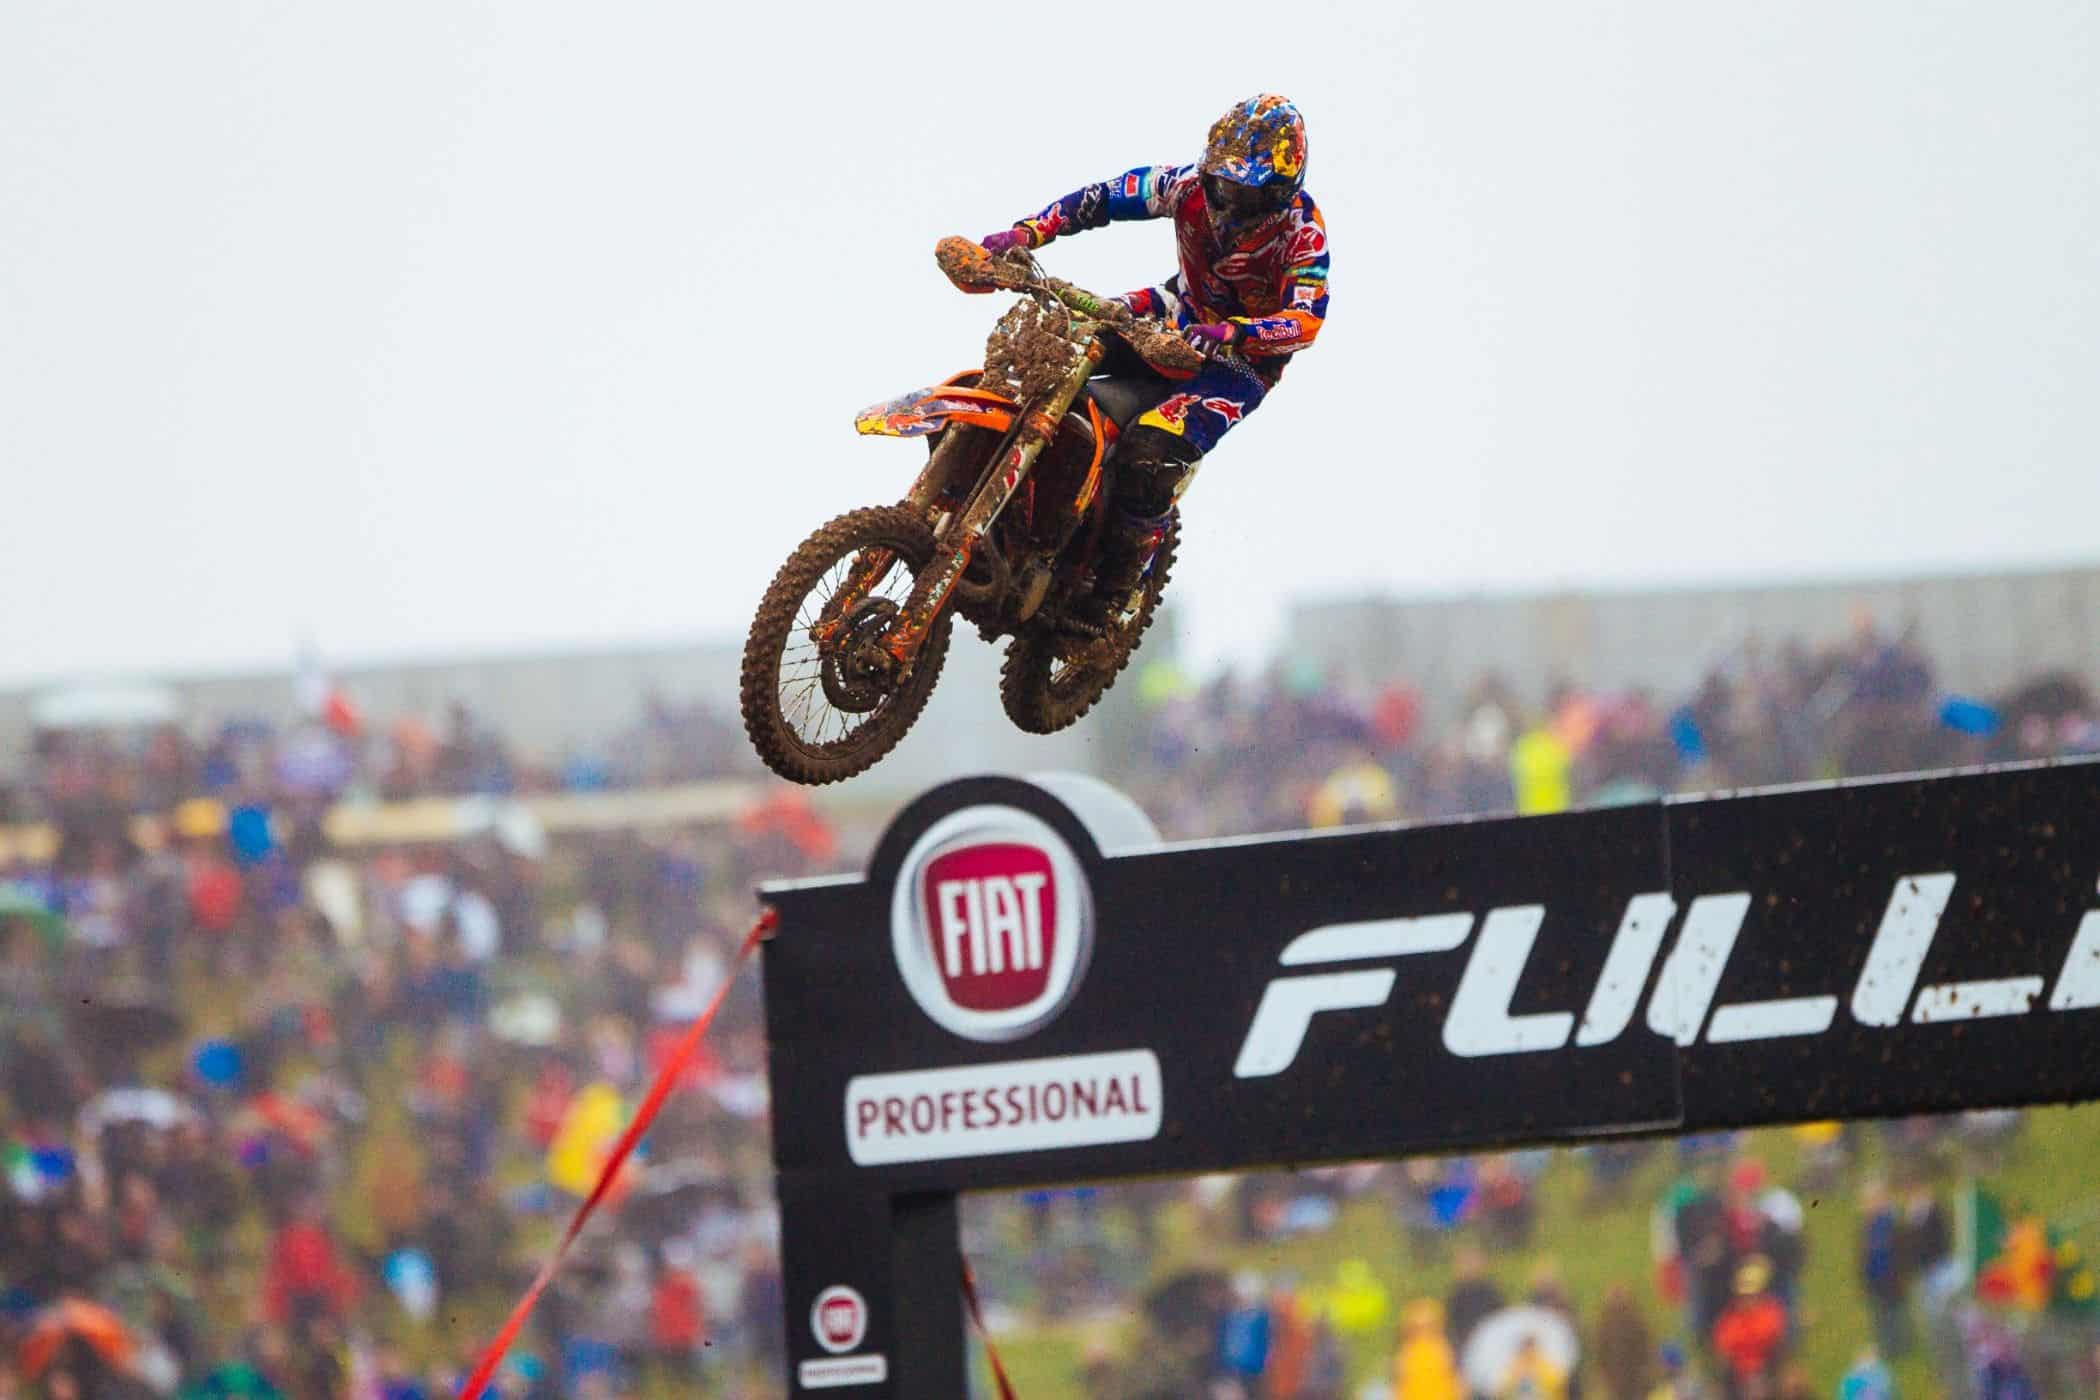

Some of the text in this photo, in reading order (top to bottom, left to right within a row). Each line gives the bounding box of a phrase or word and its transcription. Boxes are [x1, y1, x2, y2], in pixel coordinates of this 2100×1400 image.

[938, 871, 1046, 978] FIAT
[1234, 868, 2100, 1078] FULL
[856, 1074, 1149, 1140] PROFESSIONAL
